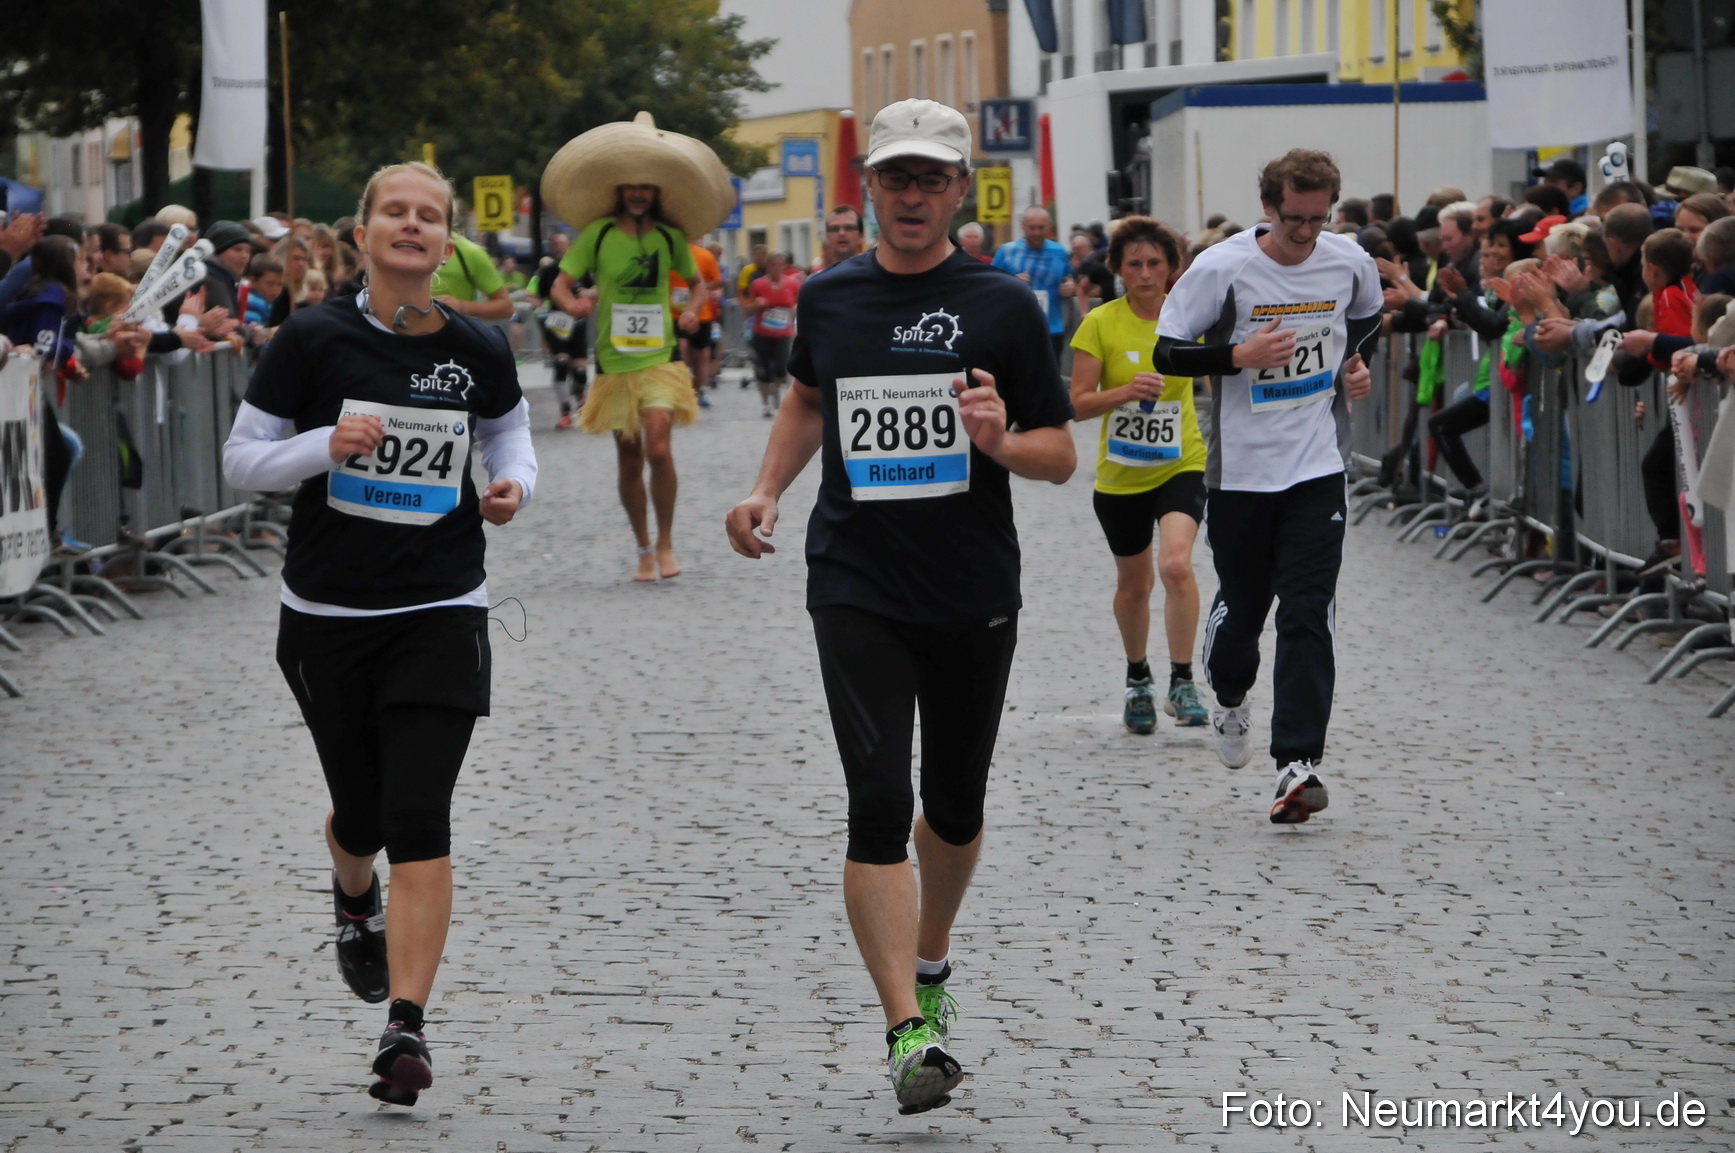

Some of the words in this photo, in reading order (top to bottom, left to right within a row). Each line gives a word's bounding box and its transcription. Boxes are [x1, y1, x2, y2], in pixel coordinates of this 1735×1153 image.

[484, 193, 503, 218] D
[987, 185, 1005, 209] D
[627, 316, 648, 334] 32
[893, 326, 935, 343] Spitz
[1296, 332, 1318, 342] markt
[410, 373, 452, 391] Spitz
[1263, 379, 1325, 399] Maximilian
[840, 389, 879, 401] PARTL
[882, 387, 943, 399] Neumarkt
[388, 417, 448, 433] Neumarkt
[851, 404, 956, 452] 2889
[1115, 416, 1174, 443] 2365
[869, 462, 935, 482] Richard
[364, 485, 422, 507] Verena
